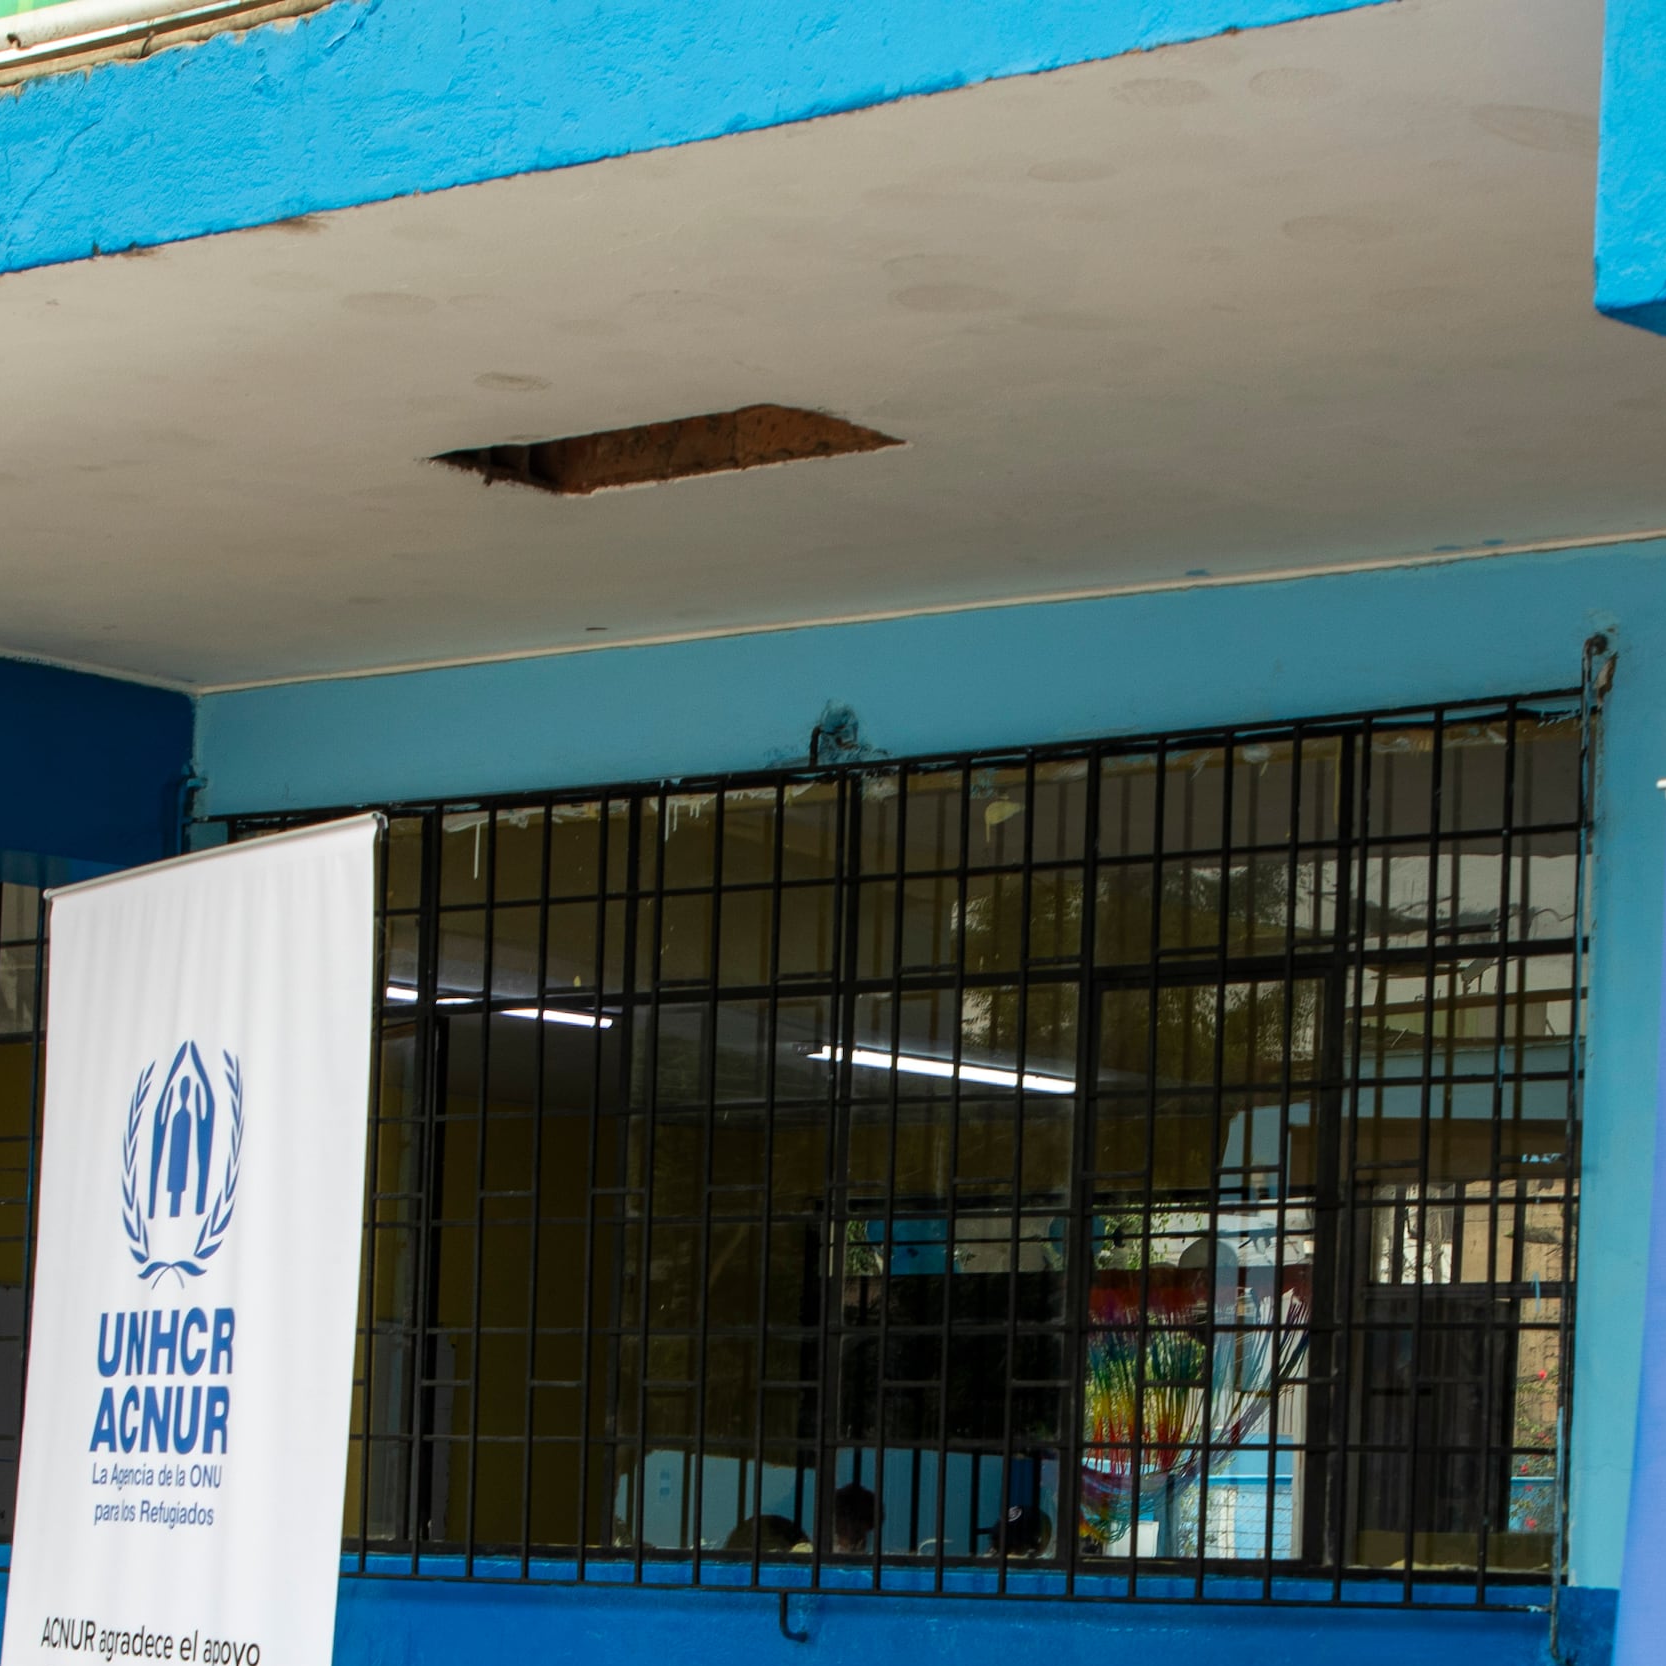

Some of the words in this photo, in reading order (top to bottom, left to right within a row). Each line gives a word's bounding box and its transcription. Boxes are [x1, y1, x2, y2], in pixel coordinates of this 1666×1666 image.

[97, 1306, 235, 1378] UNHCR
[89, 1385, 230, 1455] ACNUR
[92, 1462, 107, 1485] La
[110, 1463, 154, 1491] Agencia
[158, 1464, 172, 1486] de
[175, 1464, 185, 1486] la
[190, 1464, 222, 1489] ONU
[94, 1503, 119, 1526] para
[121, 1499, 135, 1522] los
[139, 1500, 214, 1530] Refugiados
[41, 1616, 96, 1651] ACNUR
[99, 1625, 173, 1662] agradece
[180, 1629, 198, 1662] el
